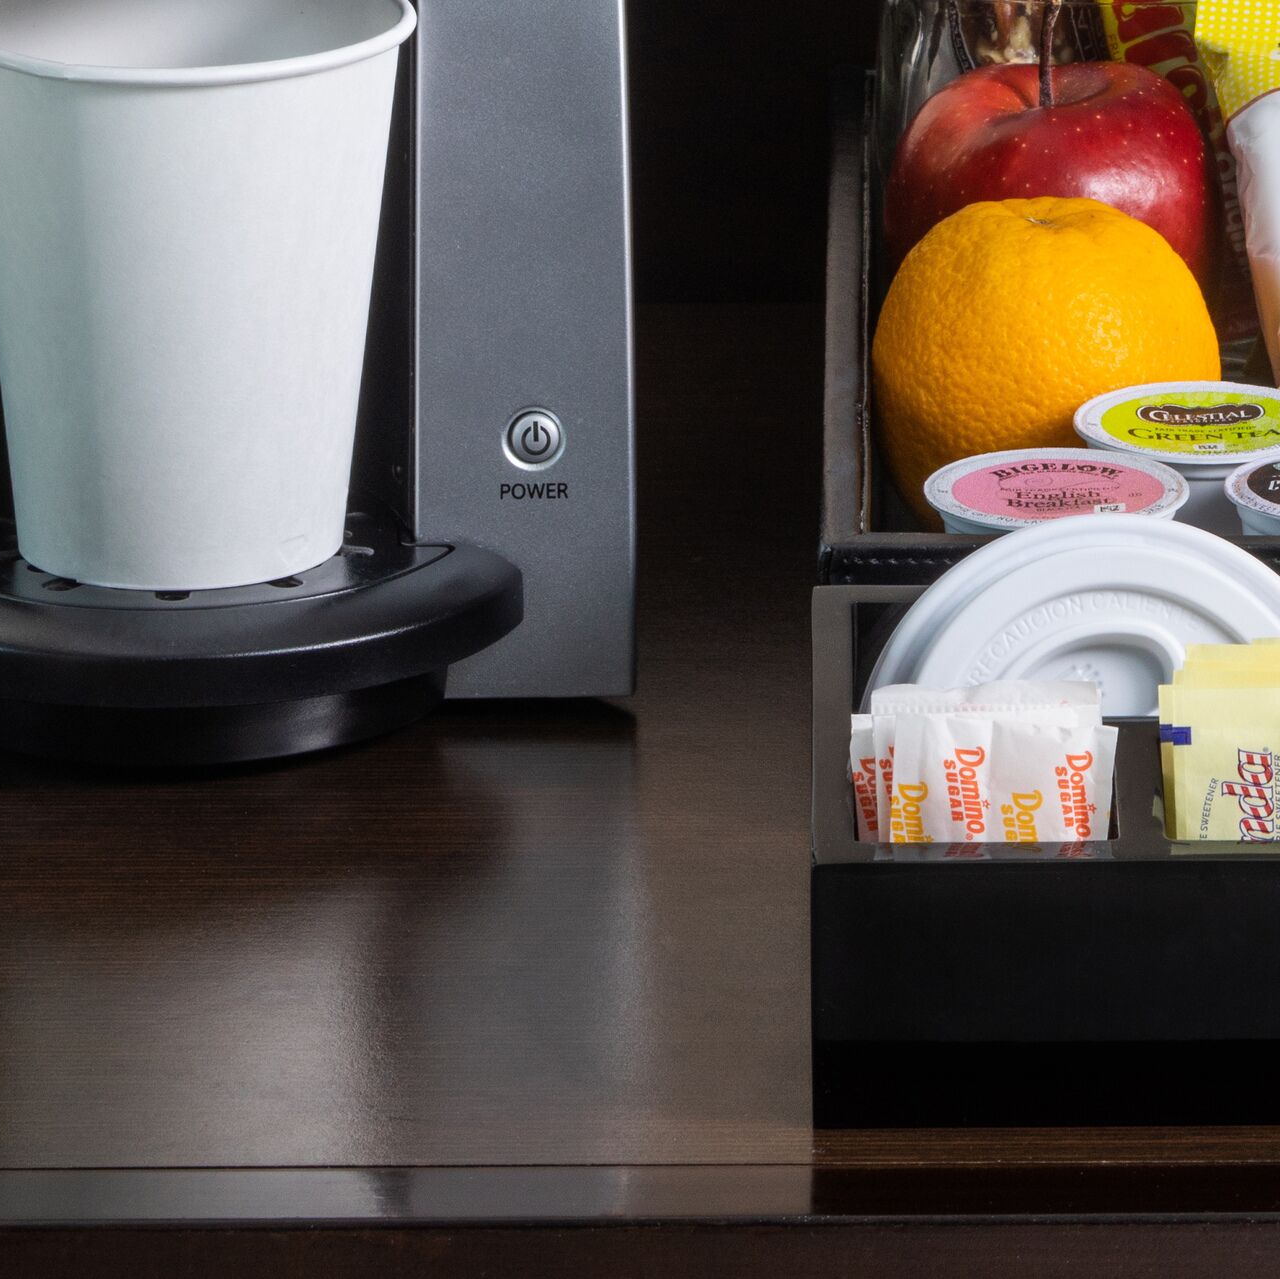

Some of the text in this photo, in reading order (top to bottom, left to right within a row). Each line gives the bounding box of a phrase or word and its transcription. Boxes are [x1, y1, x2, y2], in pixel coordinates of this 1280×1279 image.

[1127, 428, 1224, 441] GREEN
[1149, 409, 1253, 422] CELESTIAL
[500, 483, 568, 500] POWER
[989, 463, 1124, 478] BIGELOW
[1016, 490, 1101, 501] English
[1007, 497, 1110, 508] Breakfast
[966, 591, 1084, 688] RECAUCION
[853, 771, 878, 832] SUGAR
[898, 780, 929, 842] Domi
[943, 759, 964, 822] SUGAR
[954, 746, 986, 834] Domino
[1054, 766, 1074, 827] SUGAR
[1065, 751, 1093, 837] Domino
[1200, 778, 1220, 831] SWEETENER
